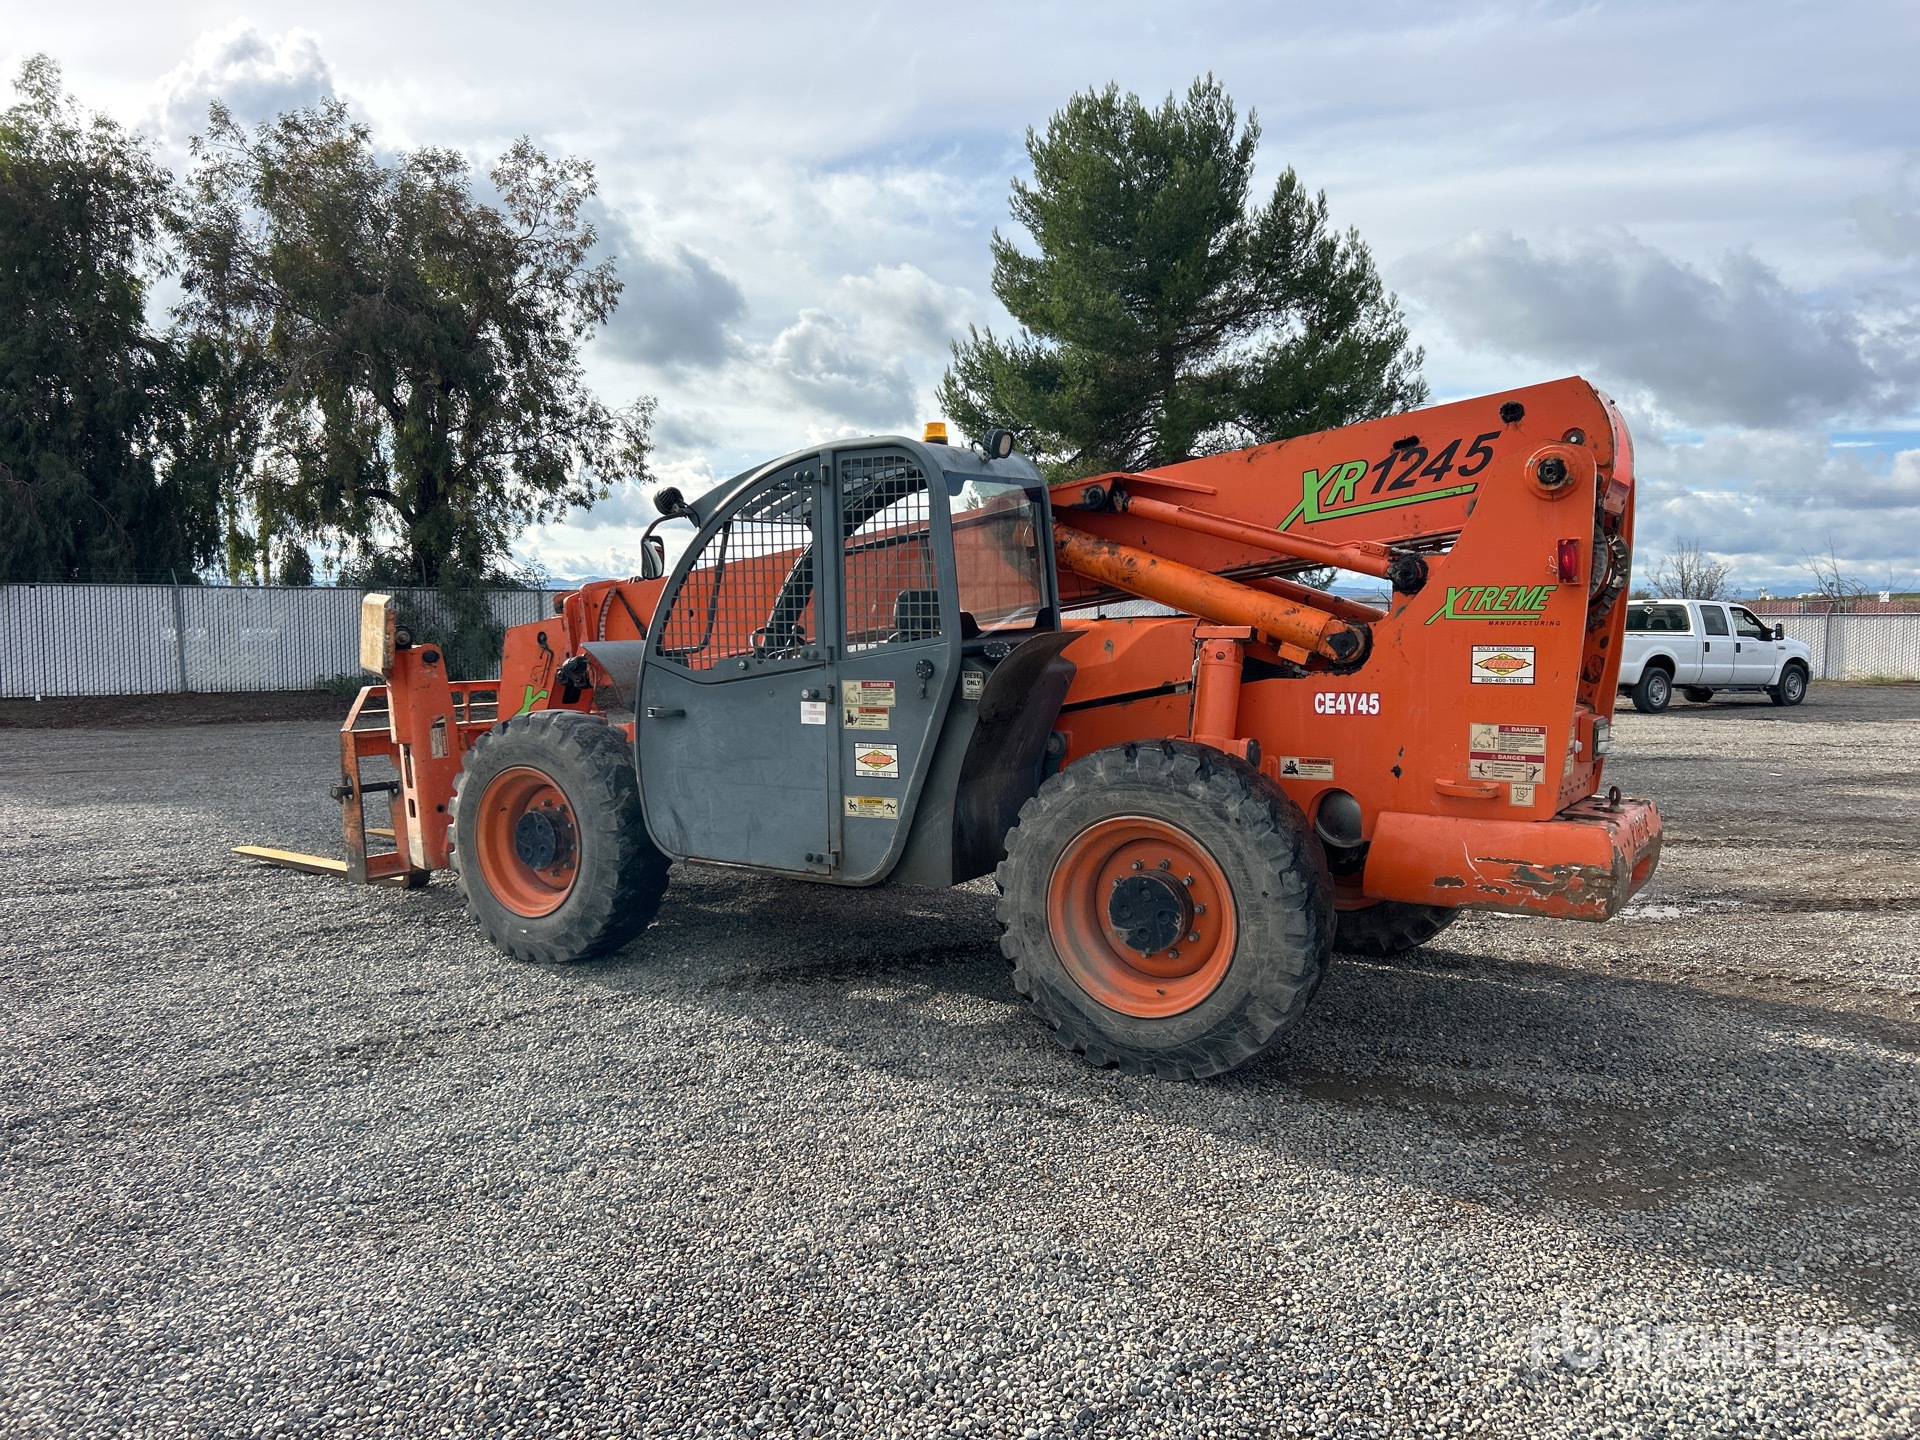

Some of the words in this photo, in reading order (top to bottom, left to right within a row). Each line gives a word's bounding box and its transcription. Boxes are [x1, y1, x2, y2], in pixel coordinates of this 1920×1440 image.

[1424, 585, 1558, 625] XTREME
[966, 679, 981, 687] ONLY
[1314, 692, 1380, 715] CE4Y45
